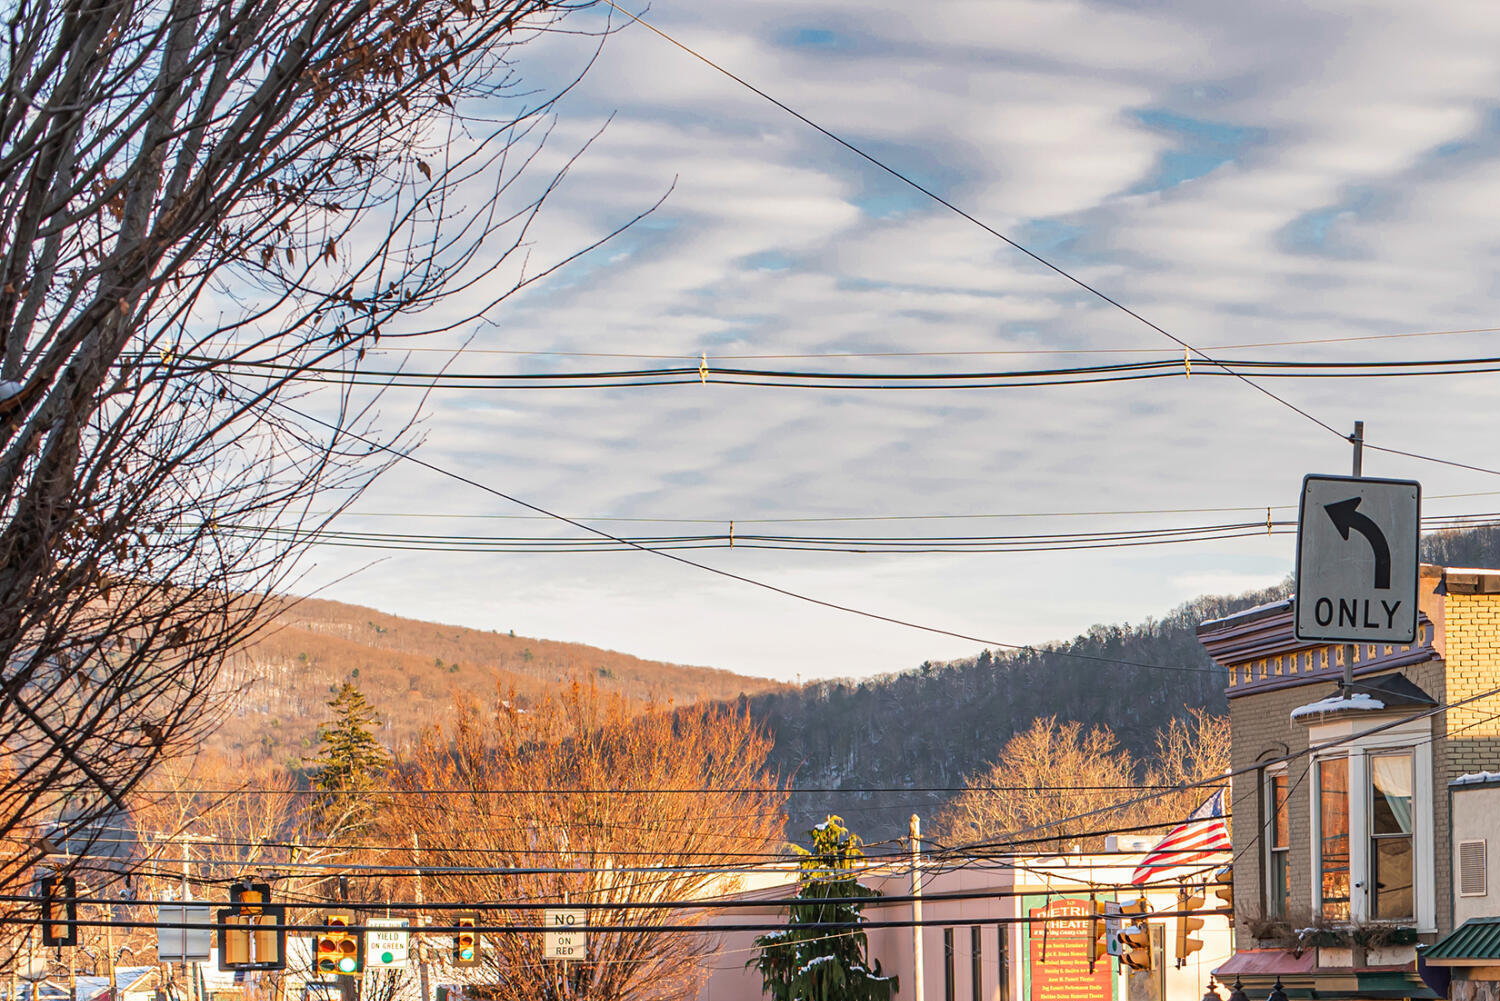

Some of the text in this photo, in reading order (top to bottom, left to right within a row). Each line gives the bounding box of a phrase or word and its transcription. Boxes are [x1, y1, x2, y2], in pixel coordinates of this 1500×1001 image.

[1314, 596, 1402, 630] ONLY
[555, 914, 575, 926] NO
[377, 932, 399, 941] YIELD
[558, 937, 572, 945] ON
[555, 946, 574, 955] RED
